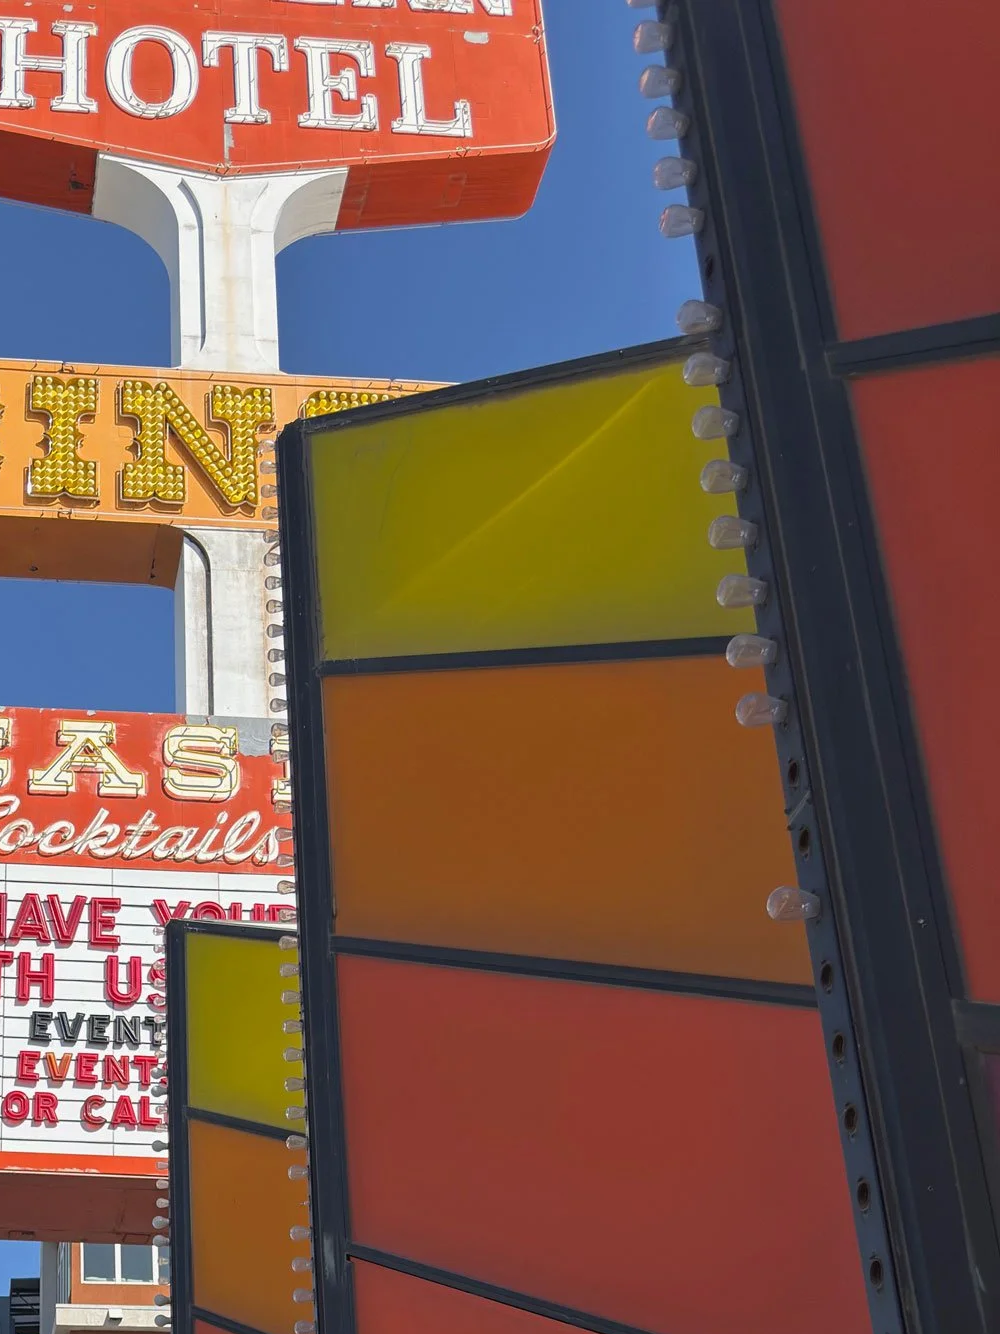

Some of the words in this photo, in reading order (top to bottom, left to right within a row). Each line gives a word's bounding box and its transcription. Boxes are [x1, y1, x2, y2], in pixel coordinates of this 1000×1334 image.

[17, 1050, 167, 1085] EVENT
[1, 1090, 59, 1123] OR
[82, 1093, 167, 1127] CAL
